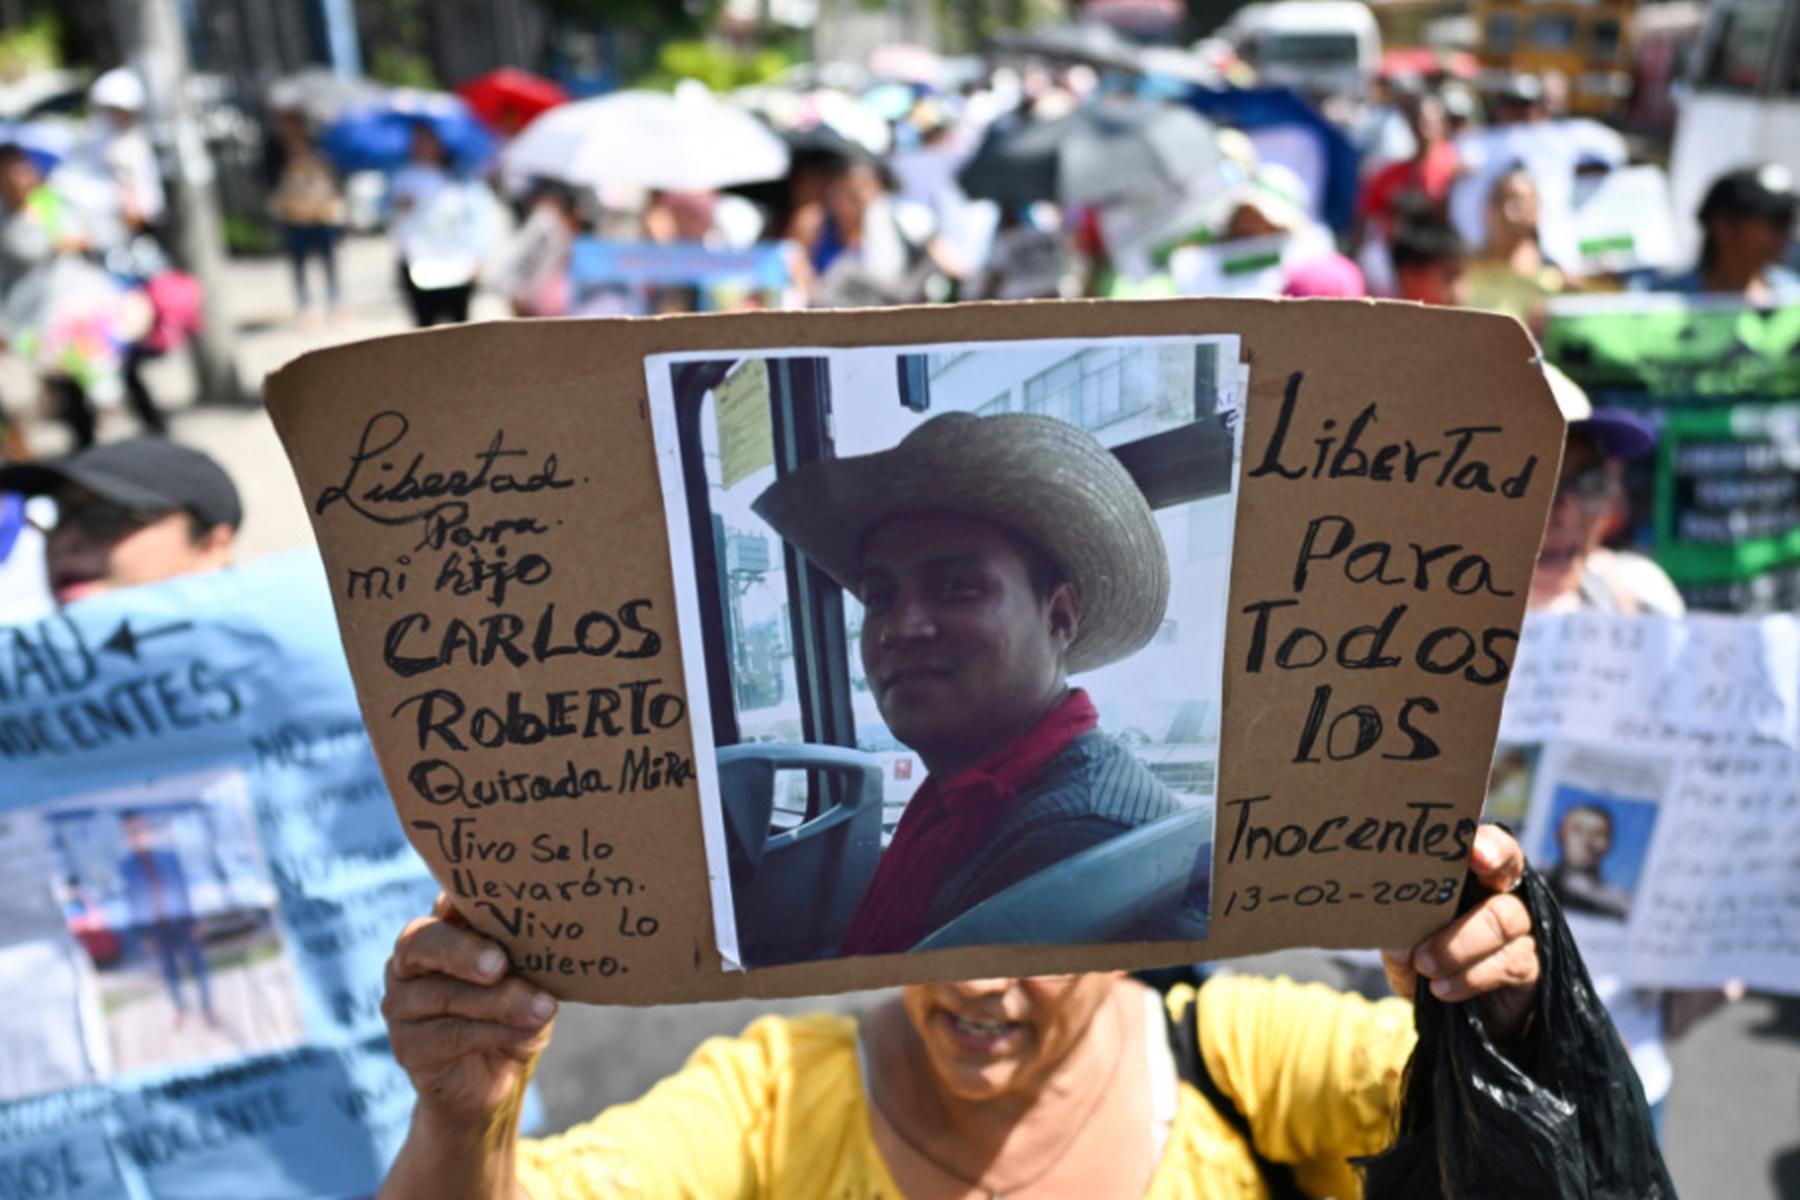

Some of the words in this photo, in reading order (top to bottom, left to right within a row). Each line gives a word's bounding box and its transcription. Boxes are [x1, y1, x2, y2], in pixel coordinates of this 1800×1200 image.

[347, 555, 411, 600] mi
[434, 545, 553, 607] hijo
[1293, 514, 1515, 597] Para
[383, 598, 662, 678] CARLOS
[1242, 599, 1521, 686] Todos
[411, 816, 517, 864] Vivo
[474, 900, 585, 941] Vivo
[511, 946, 629, 977] uiero.
